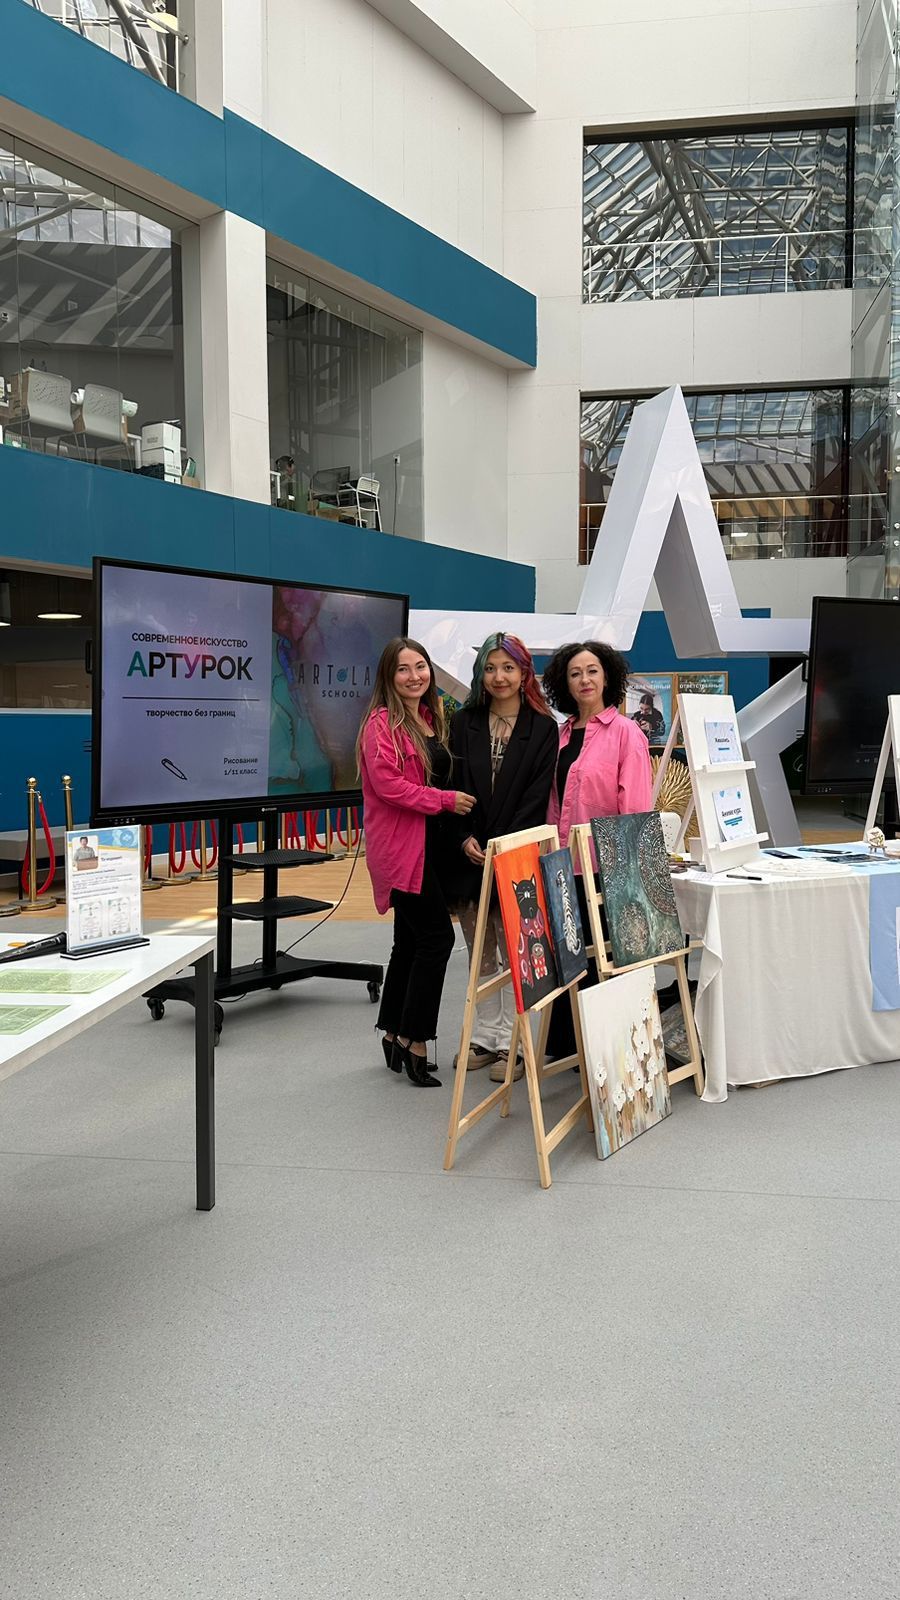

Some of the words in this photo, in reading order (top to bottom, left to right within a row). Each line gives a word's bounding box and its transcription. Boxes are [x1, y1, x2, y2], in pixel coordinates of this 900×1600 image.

[131, 632, 198, 645] СОВРЕМЕННОЕ
[200, 638, 248, 648] ИСКУССТВО
[127, 651, 253, 681] АРТУРОК
[322, 689, 360, 698] SCHOOL
[146, 710, 193, 719] творчество
[194, 708, 208, 717] без
[209, 711, 236, 719] границ
